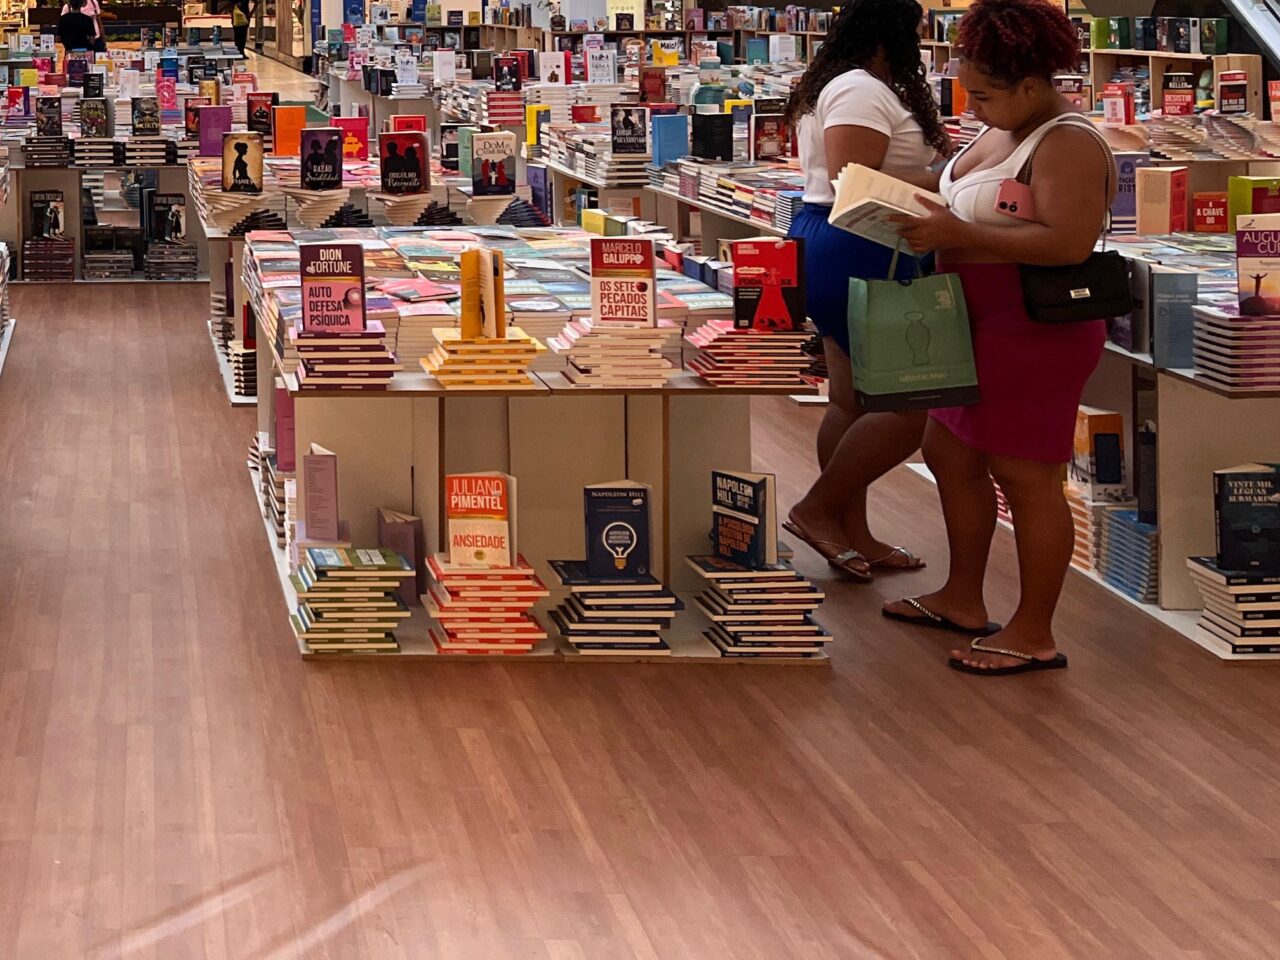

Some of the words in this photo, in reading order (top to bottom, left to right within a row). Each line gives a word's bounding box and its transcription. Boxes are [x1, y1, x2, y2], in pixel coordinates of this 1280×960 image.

[1197, 208, 1203, 216] A
[1203, 208, 1225, 217] CHAVE
[602, 242, 642, 253] MARCELO
[320, 249, 342, 261] DION
[311, 260, 353, 274] FORTUNE
[308, 286, 332, 298] AUTO
[600, 281, 612, 292] OS
[613, 281, 636, 292] SETE
[600, 292, 648, 305] PECADOS
[309, 300, 343, 312] DEFESA
[600, 304, 648, 317] CAPITAIS
[309, 313, 351, 326] PSÍQUICA
[451, 479, 503, 496] JULIANO
[717, 477, 754, 498] NAPOLEON
[451, 495, 504, 510] PIMENTEL
[717, 489, 733, 504] HILL
[453, 534, 506, 550] ANSIEDADE
